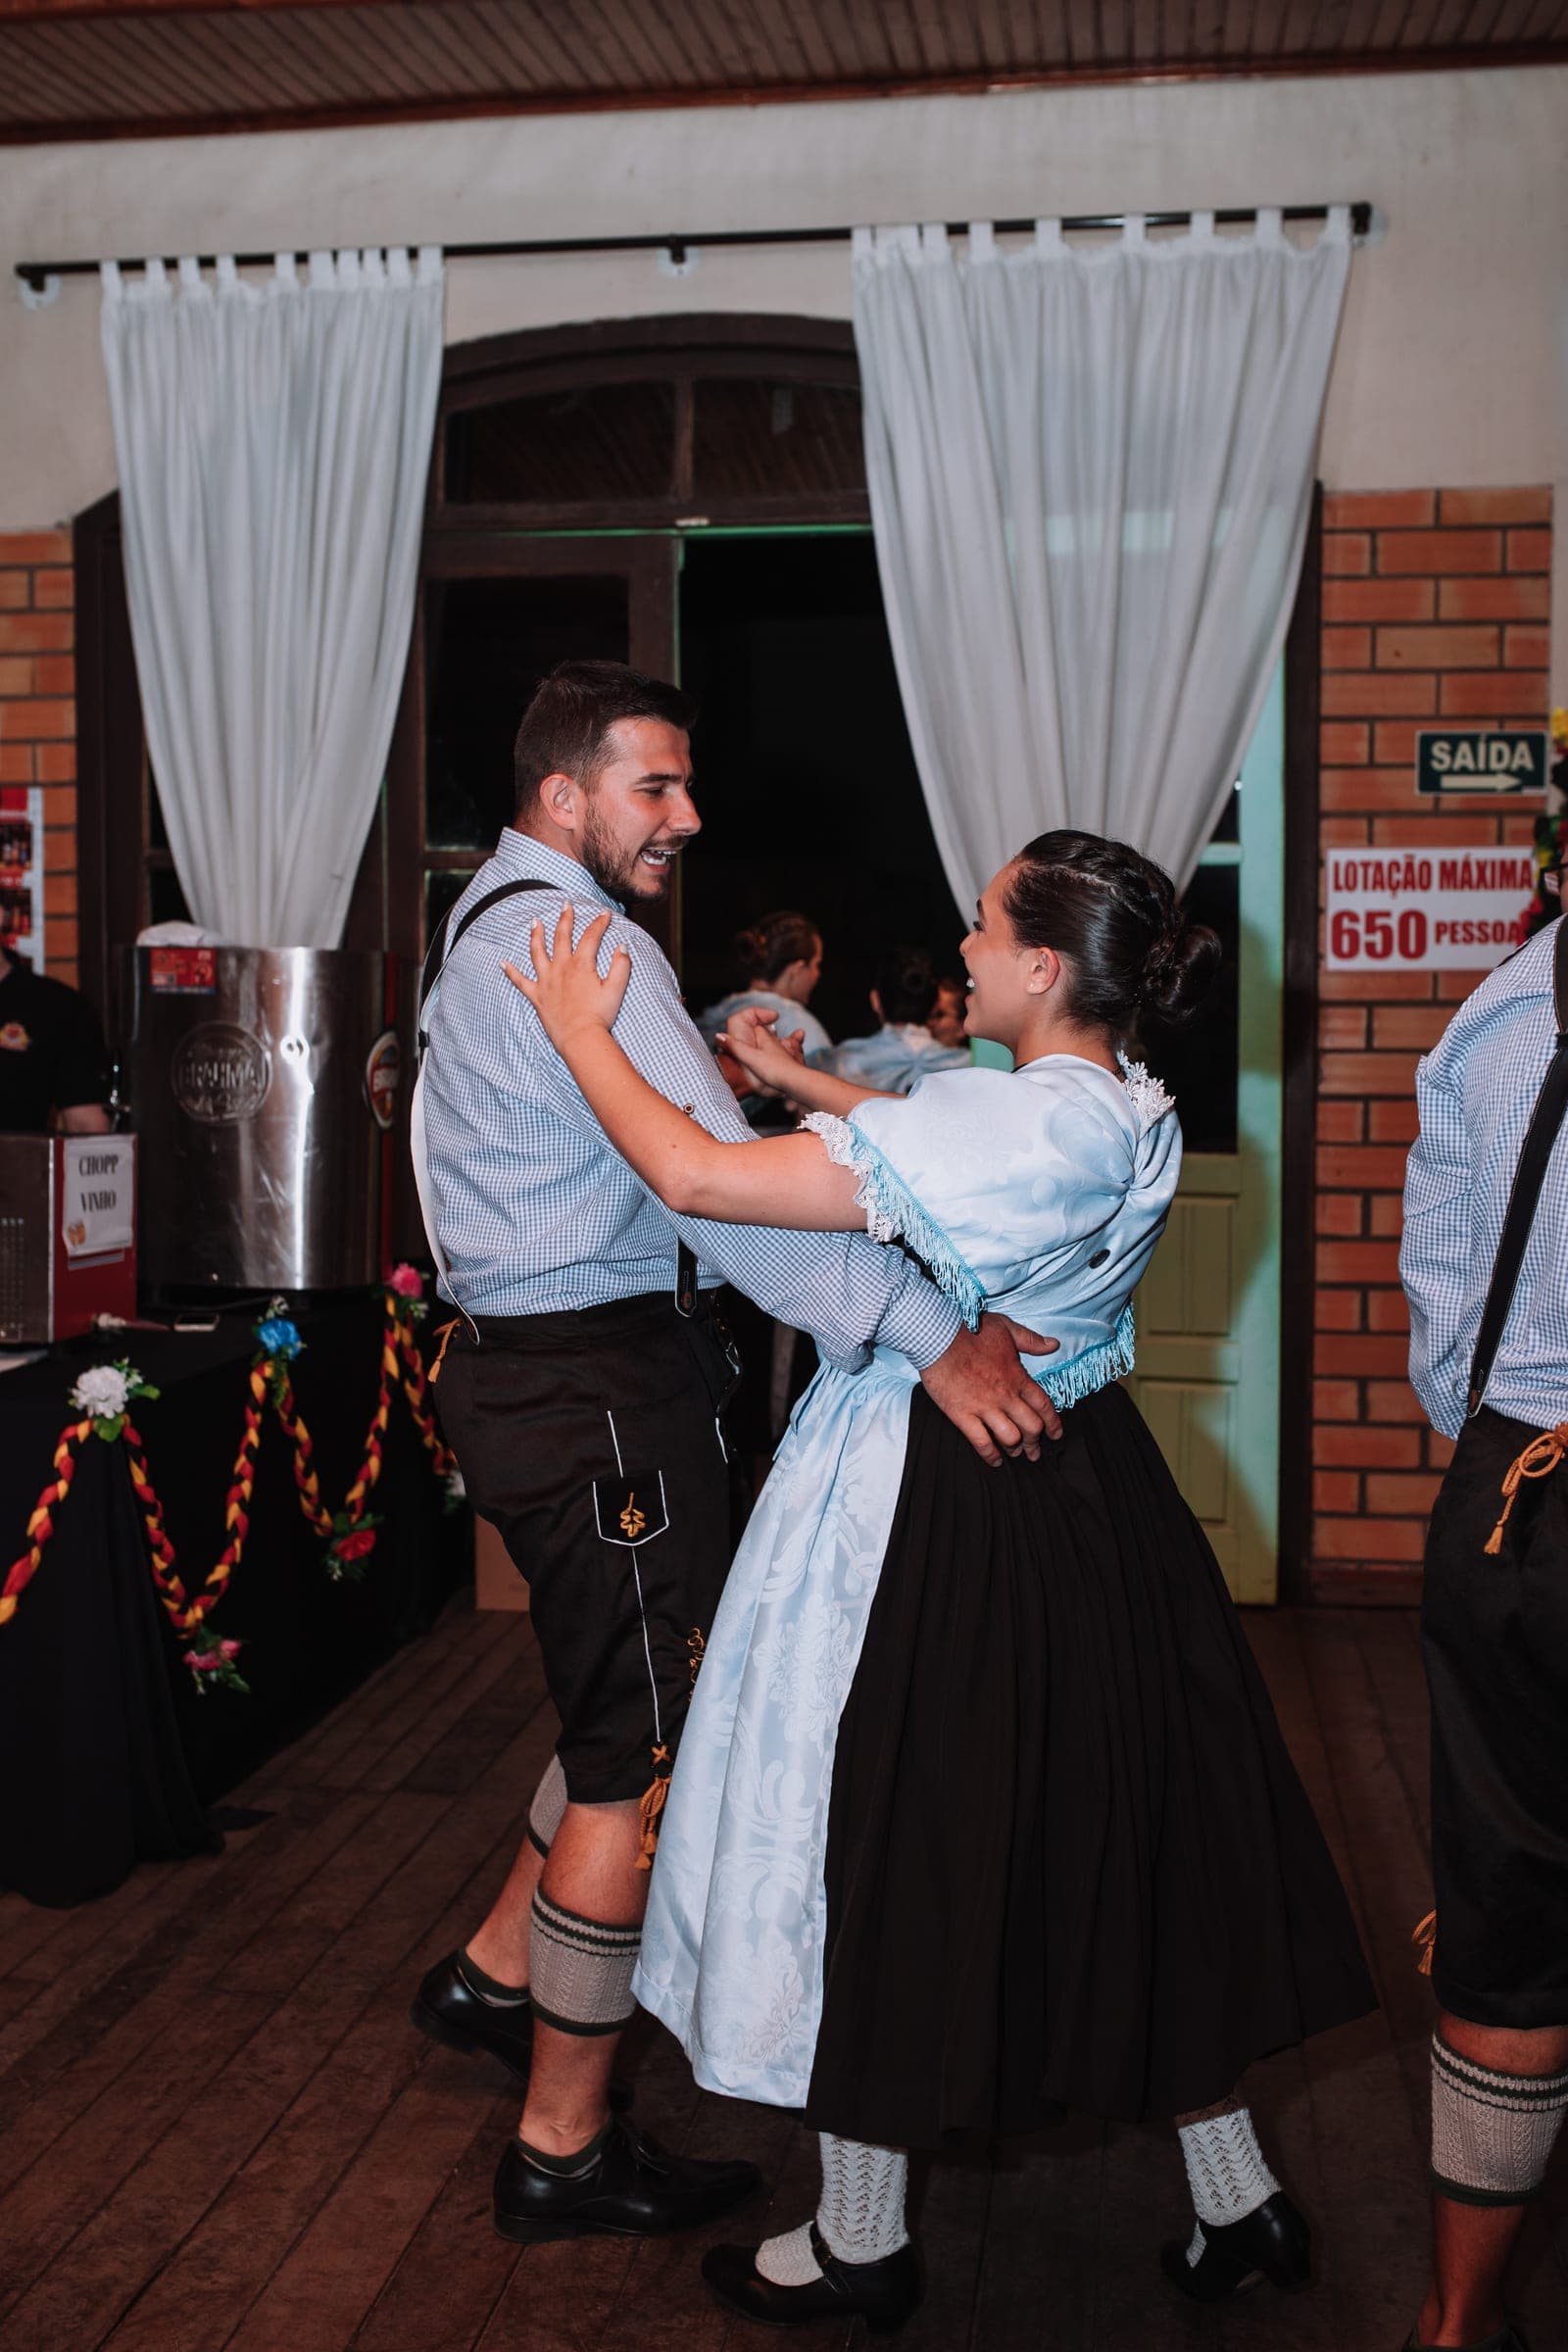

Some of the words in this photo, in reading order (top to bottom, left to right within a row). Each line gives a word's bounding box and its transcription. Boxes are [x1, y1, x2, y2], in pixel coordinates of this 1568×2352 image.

[1431, 737, 1535, 771] SAÍDA
[1333, 854, 1432, 898] LOTAÇÃO
[1439, 854, 1533, 891] MÁXIMA
[1332, 909, 1427, 960] 650
[1435, 920, 1521, 945] PESSOA
[79, 1154, 119, 1177] CHOPP
[80, 1191, 117, 1213] VINHO
